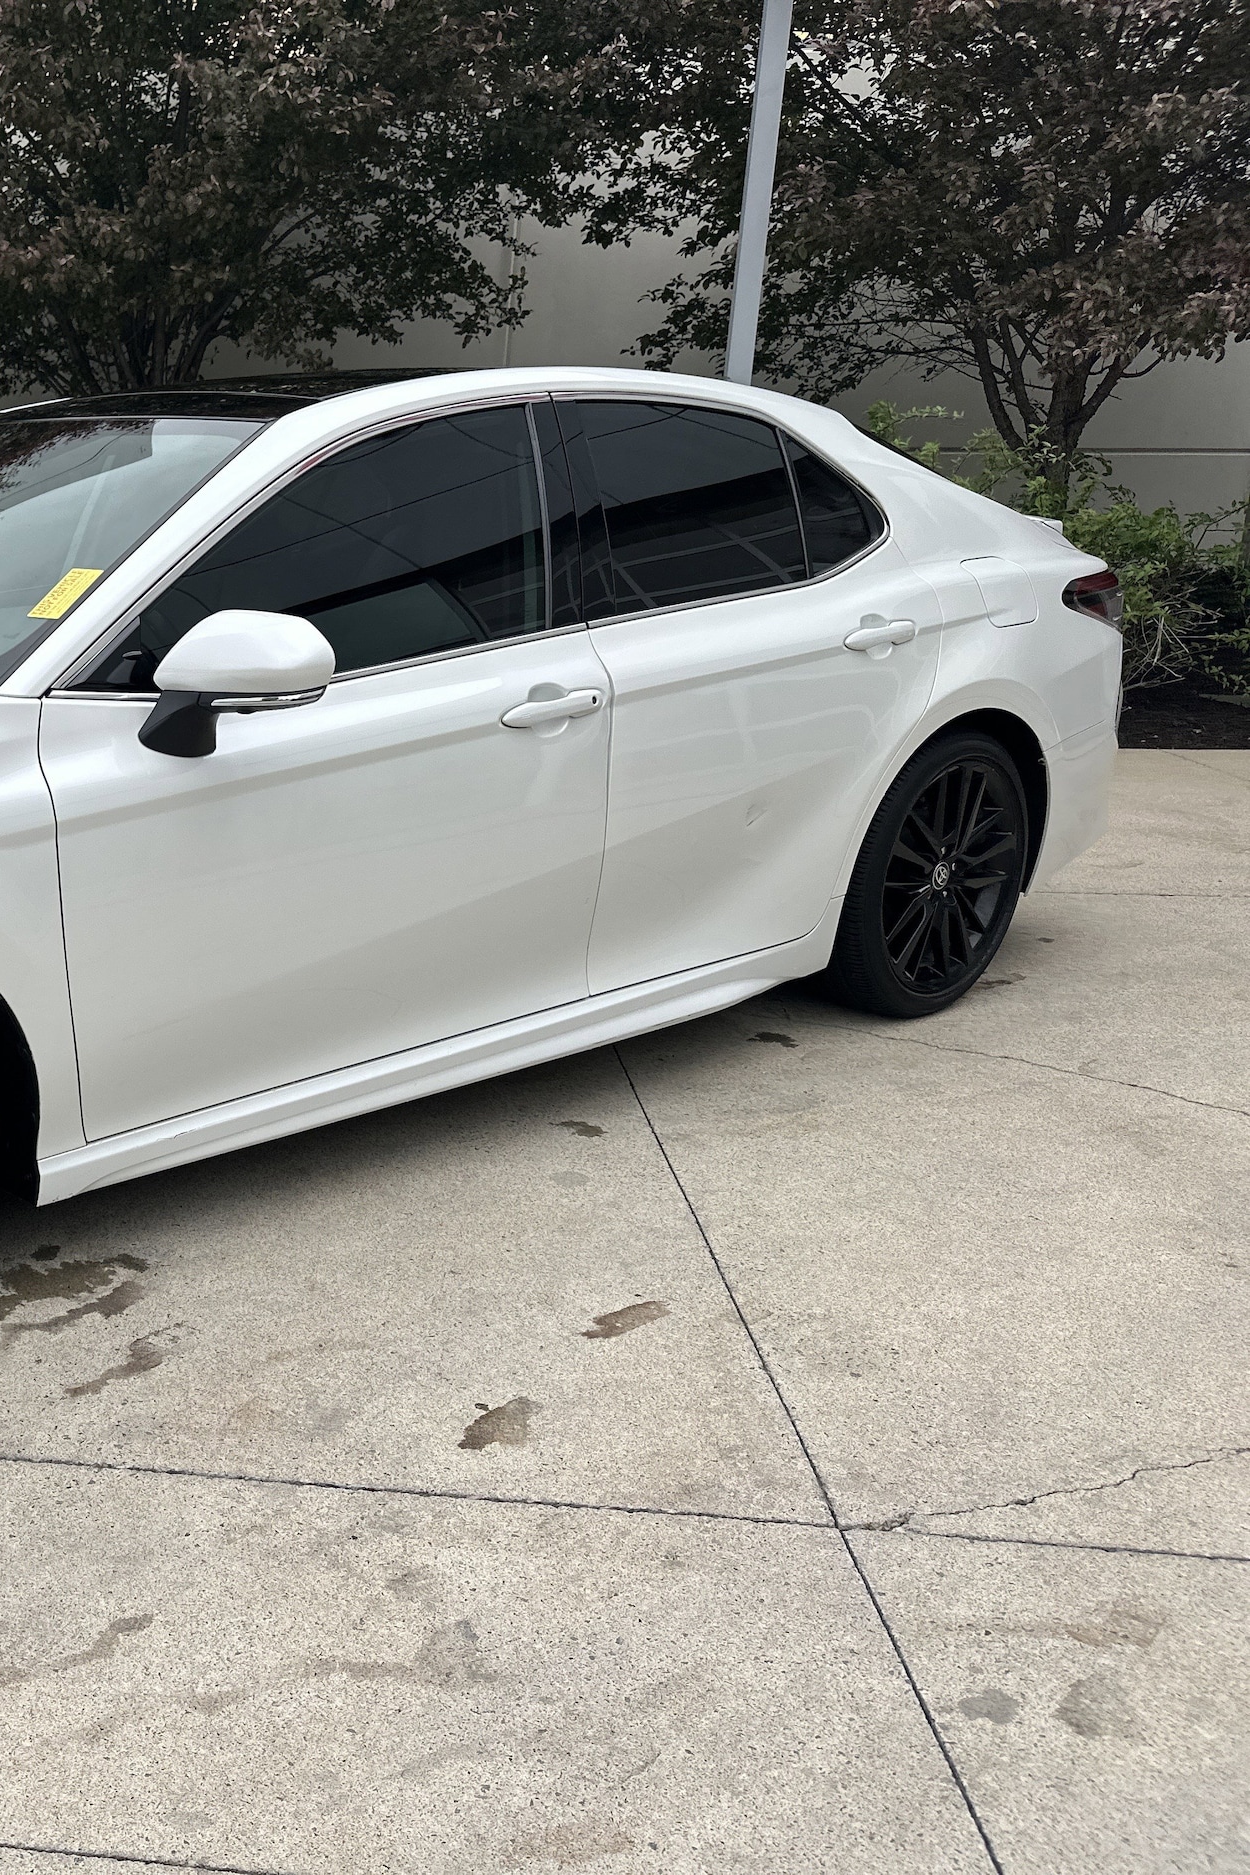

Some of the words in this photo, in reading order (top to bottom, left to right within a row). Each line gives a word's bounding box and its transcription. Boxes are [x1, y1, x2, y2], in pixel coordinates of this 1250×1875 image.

[38, 600, 54, 615] NOT
[53, 587, 68, 600] FOR
[67, 571, 84, 586] SALE
[48, 571, 78, 598] VEHICLE
